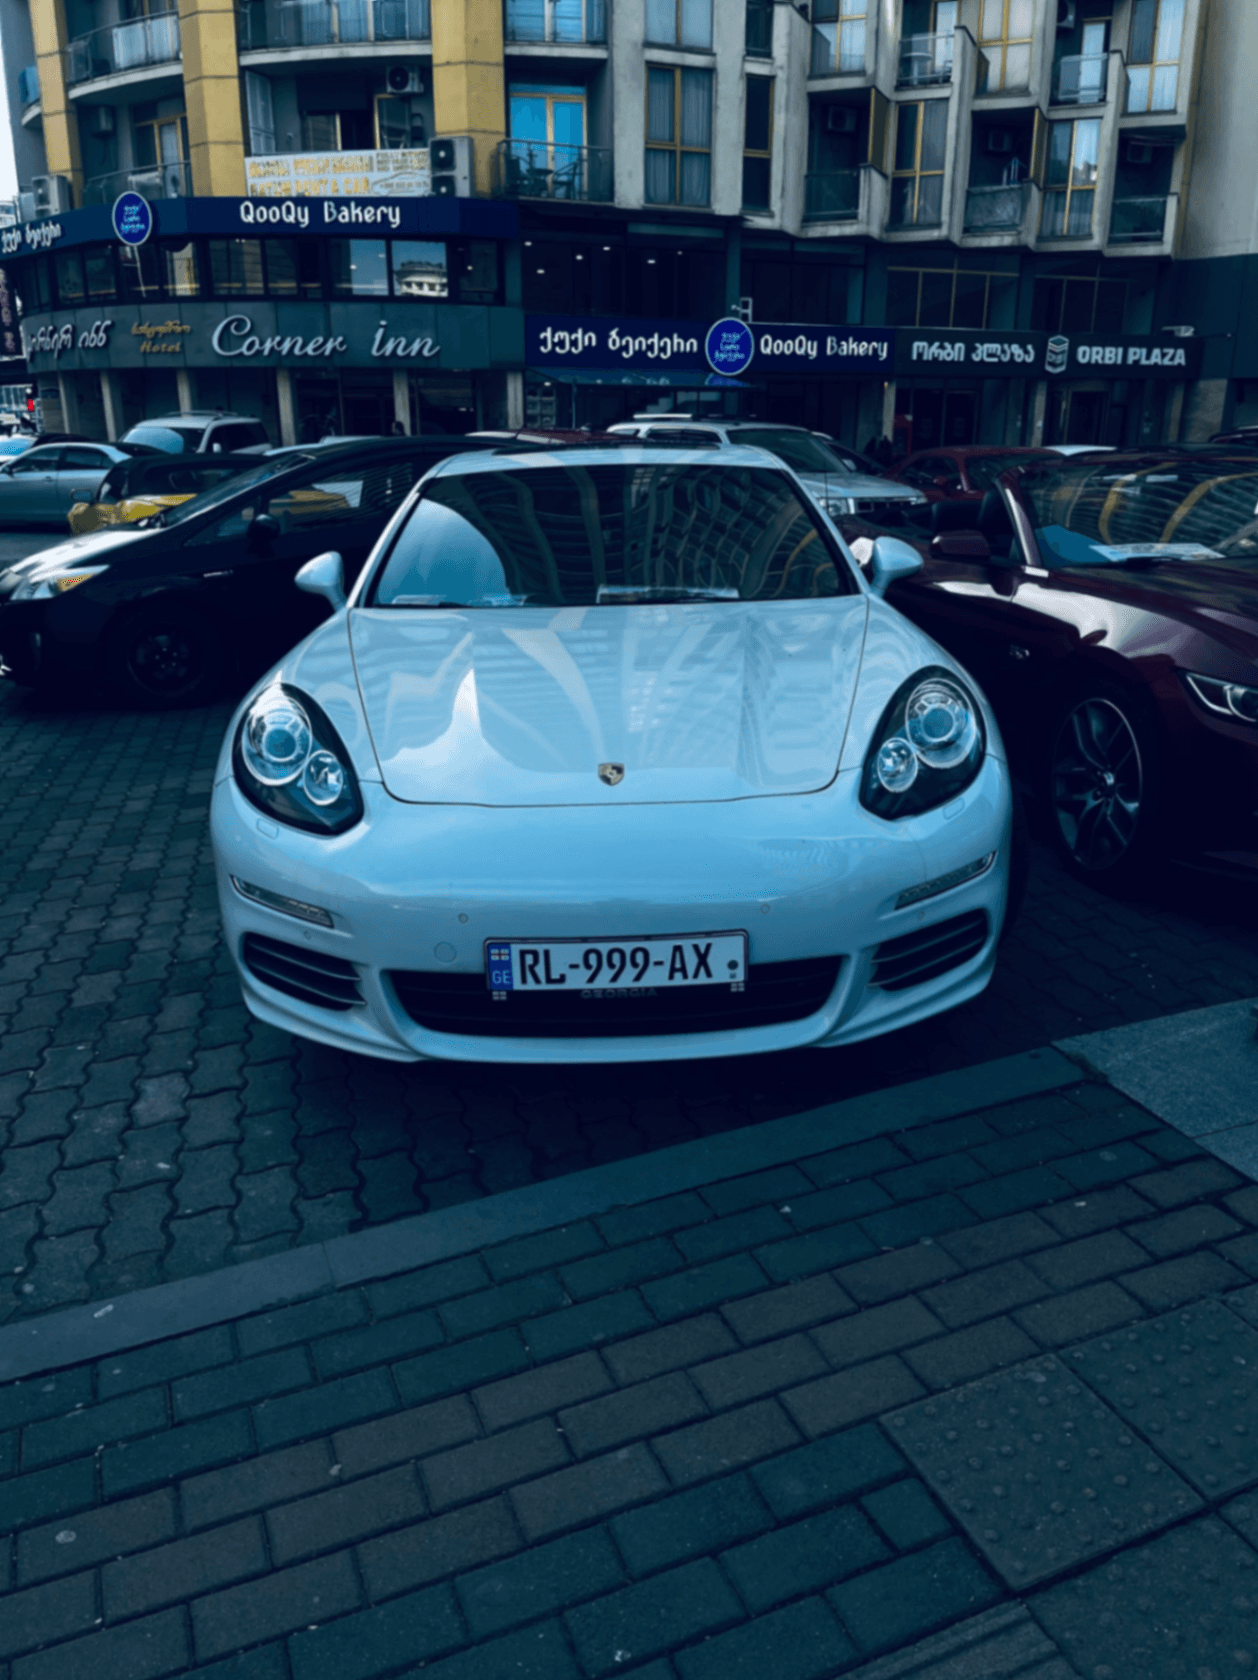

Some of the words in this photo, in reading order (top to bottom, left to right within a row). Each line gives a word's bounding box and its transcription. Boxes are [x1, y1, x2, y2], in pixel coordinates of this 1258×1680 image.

[239, 200, 310, 229] QooQy
[323, 200, 401, 229] Bakery
[211, 313, 348, 357] Corner
[370, 319, 441, 358] inn
[759, 333, 818, 360] QooQy
[826, 335, 889, 361] Bakery
[1076, 345, 1123, 365] ORBI
[1126, 346, 1187, 367] PLAZA
[492, 969, 511, 985] GE
[518, 942, 714, 986] RL-999-AX
